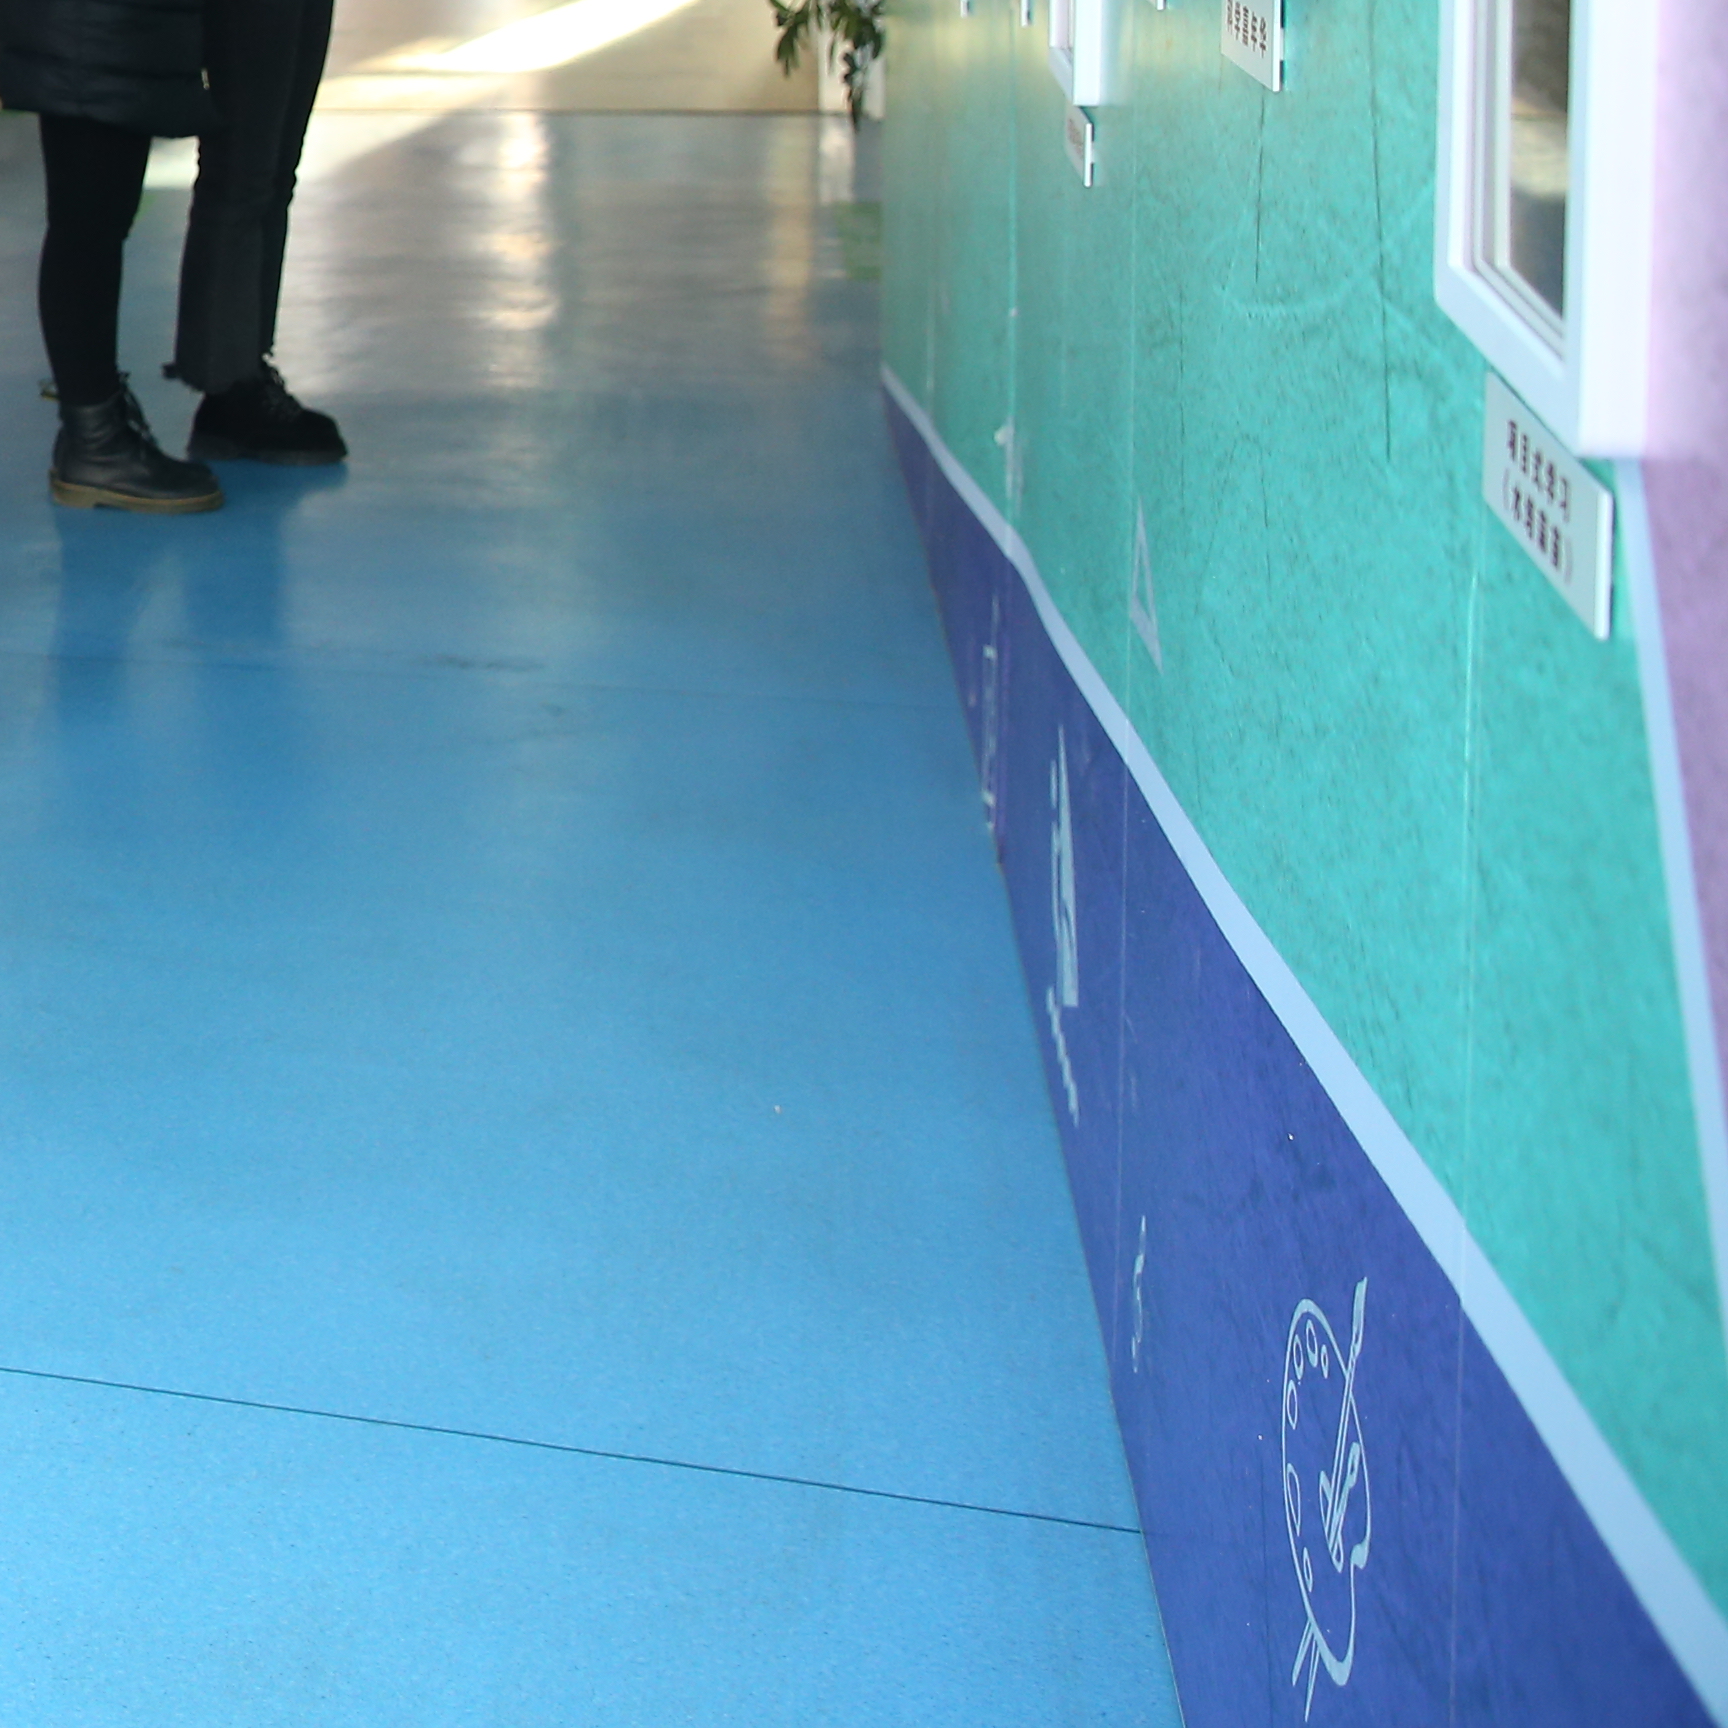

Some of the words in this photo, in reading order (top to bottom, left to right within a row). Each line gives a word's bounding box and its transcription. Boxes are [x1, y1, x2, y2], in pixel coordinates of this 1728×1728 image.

[1506, 418, 1572, 522] 项目式学习
